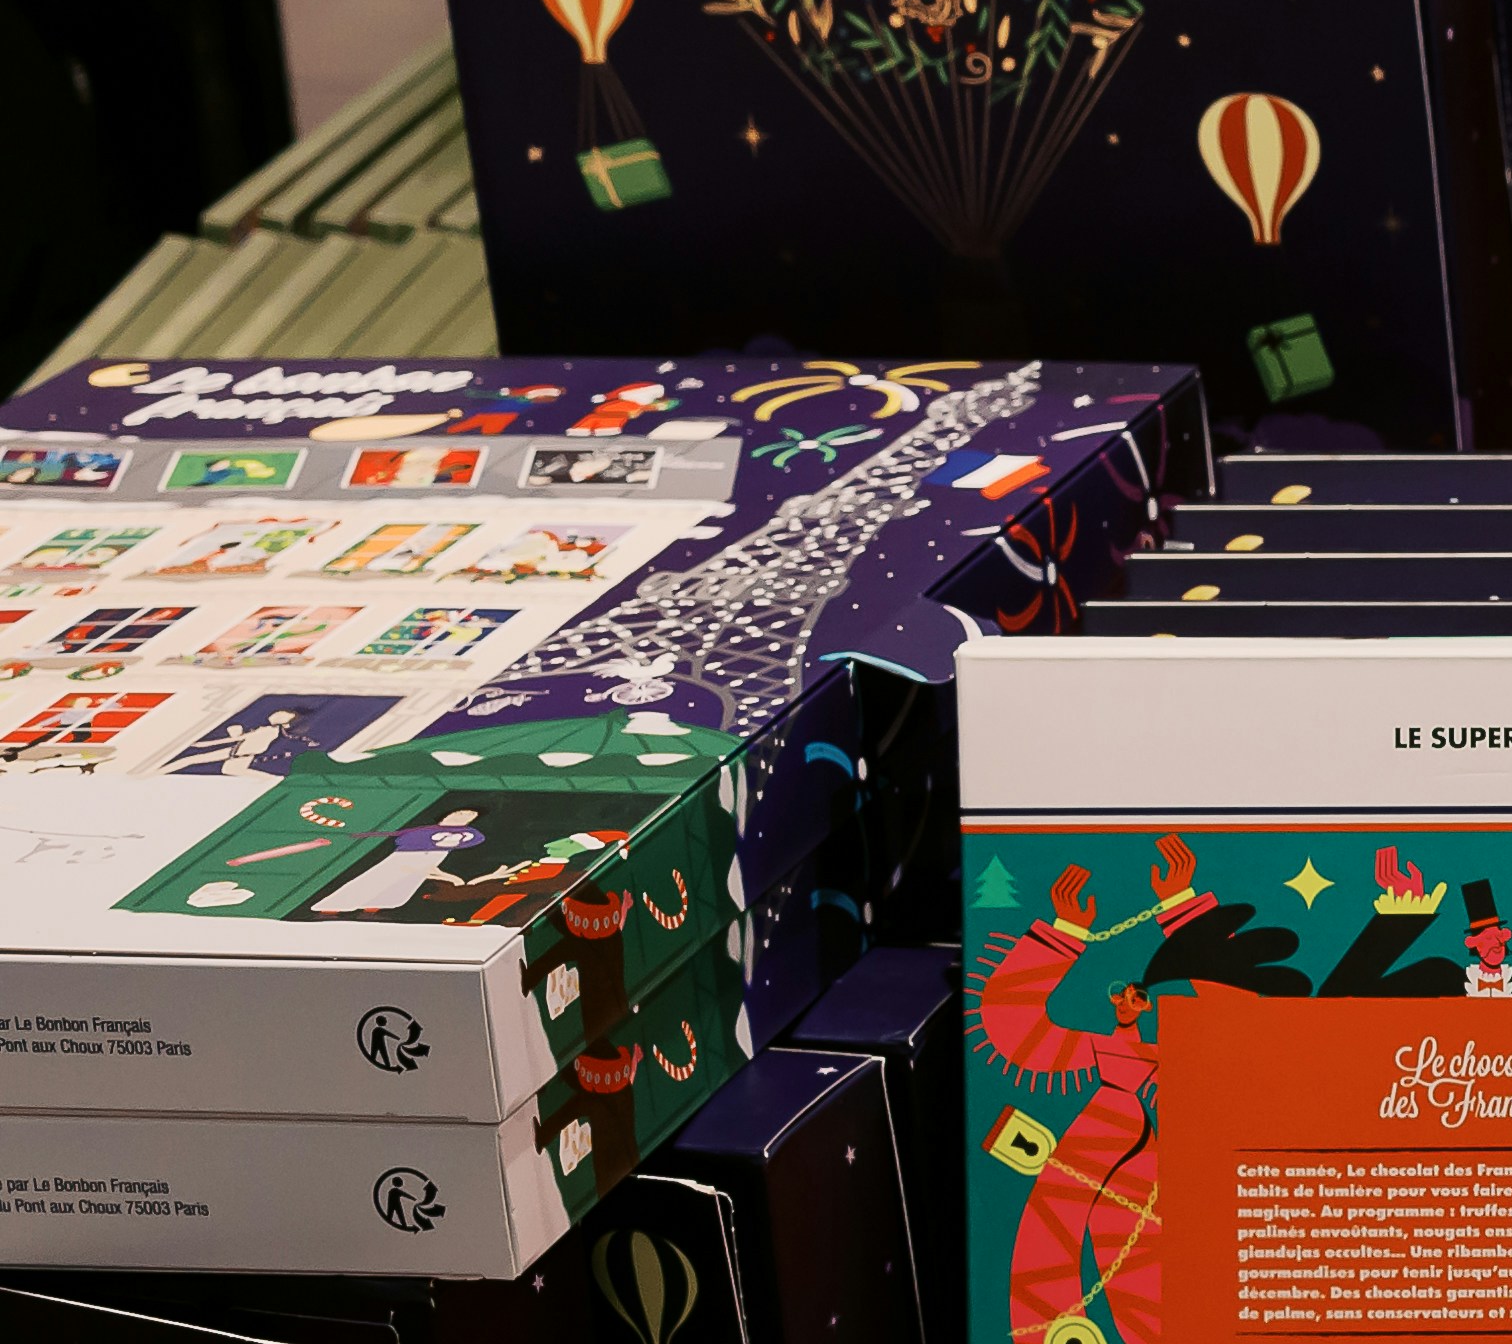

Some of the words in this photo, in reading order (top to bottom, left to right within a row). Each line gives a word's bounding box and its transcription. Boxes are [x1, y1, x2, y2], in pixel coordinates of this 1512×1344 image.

[1395, 727, 1421, 749] LE
[15, 1016, 32, 1031] Le
[36, 1016, 89, 1032] Bonbon
[93, 1017, 152, 1037] Français
[0, 1038, 29, 1053] Pont
[32, 1041, 57, 1054] aux
[60, 1038, 104, 1054] Choux
[107, 1039, 153, 1055] 75003
[156, 1041, 193, 1056] Paris
[1395, 1036, 1446, 1088] Le
[1379, 1082, 1419, 1119] des
[1237, 1164, 1281, 1178] Cette
[1347, 1164, 1366, 1177] Le
[1370, 1162, 1440, 1177] chocolat
[1444, 1162, 1473, 1177] des
[7, 1180, 29, 1194] par
[33, 1178, 50, 1192] Le
[54, 1177, 107, 1193] Bonbon
[110, 1178, 170, 1198] Français
[15, 1199, 46, 1214] Pont
[50, 1202, 74, 1215] aux
[78, 1199, 123, 1215] Choux
[125, 1200, 171, 1216] 75003
[174, 1201, 210, 1217] Paris
